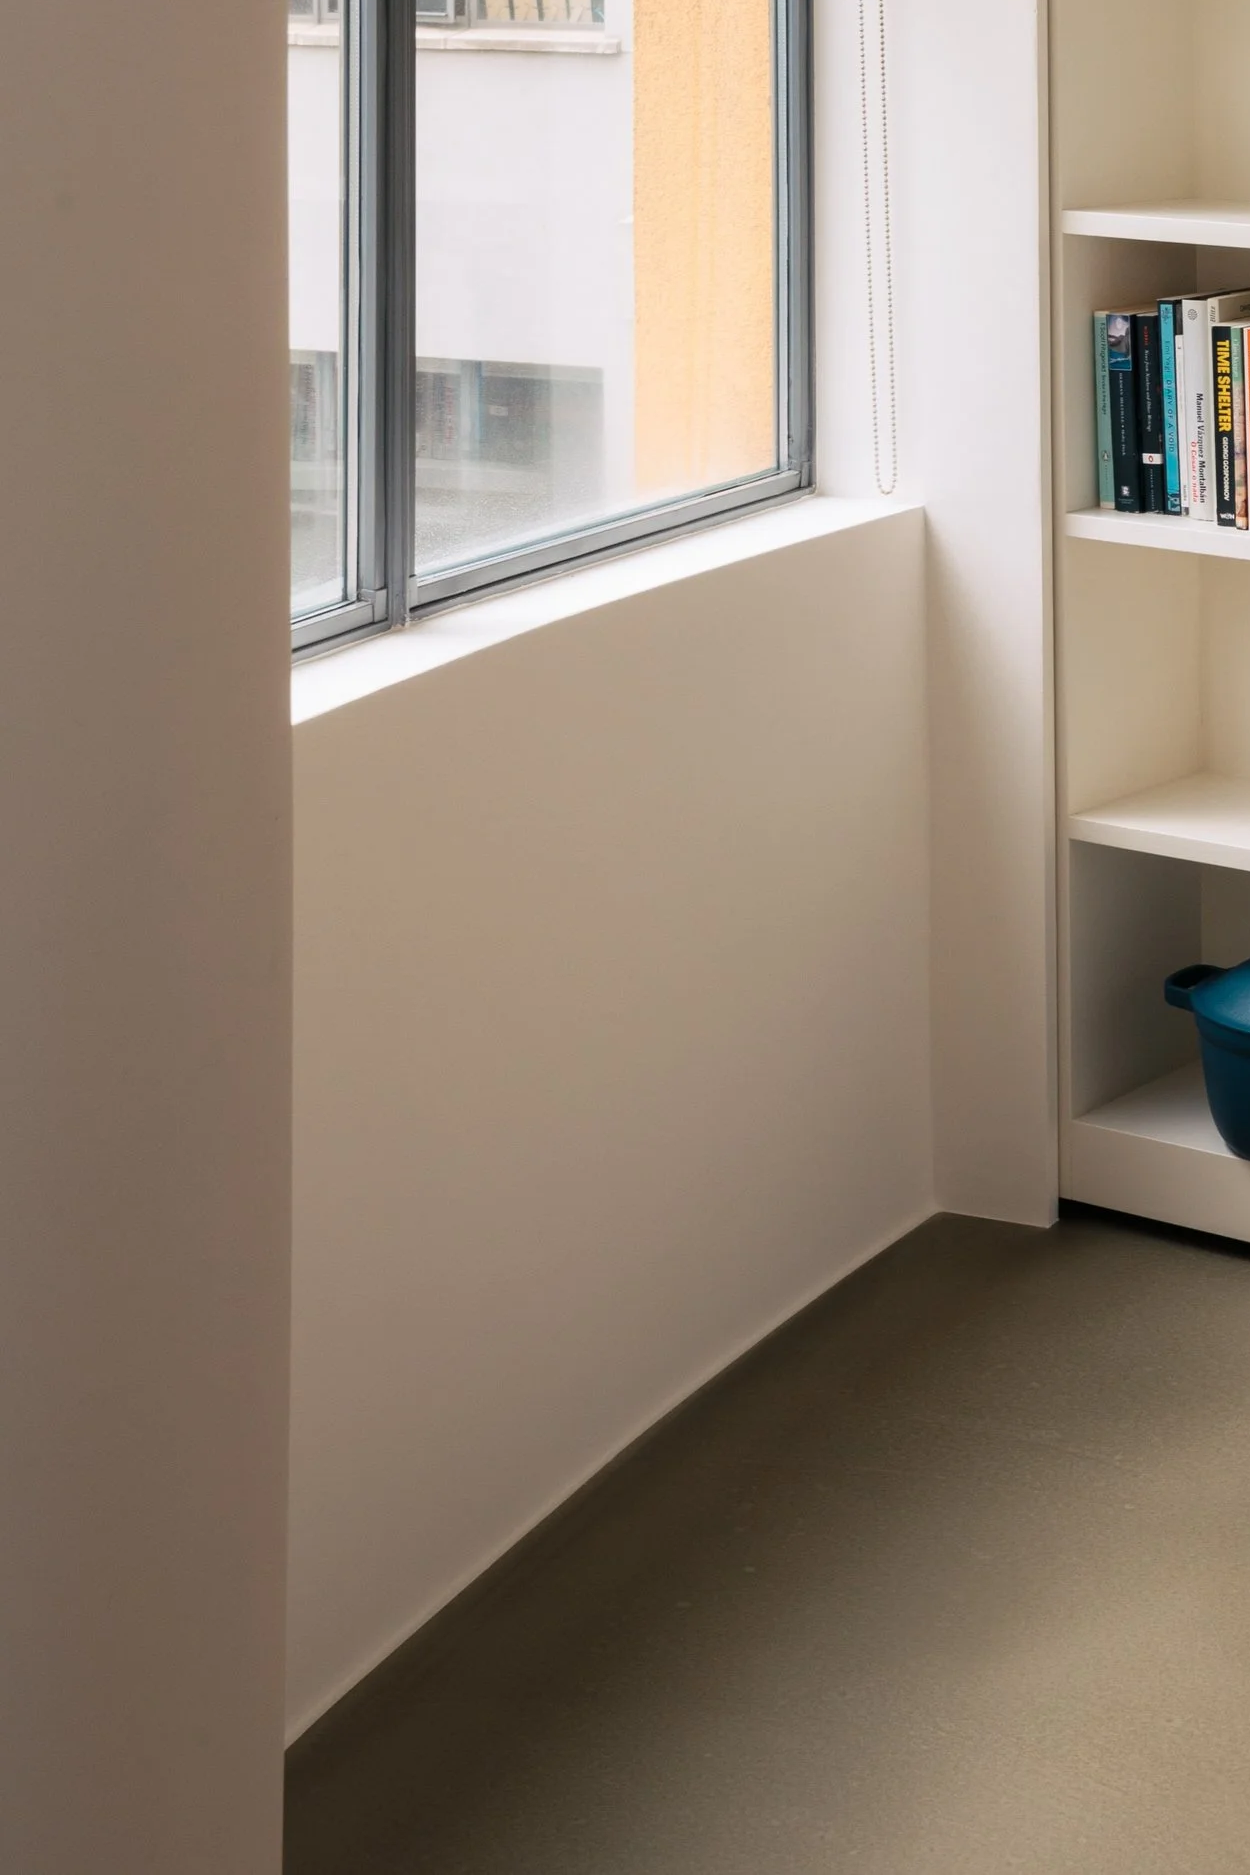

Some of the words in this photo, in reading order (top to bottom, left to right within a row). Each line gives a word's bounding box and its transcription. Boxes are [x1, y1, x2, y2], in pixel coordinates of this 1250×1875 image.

[1217, 340, 1230, 373] TIME
[1167, 409, 1173, 419] OF
[1196, 393, 1204, 423] Manuel
[1217, 375, 1231, 432] SHELTER
[1196, 425, 1205, 458] Vázquez
[1198, 460, 1206, 503] Montalbán
